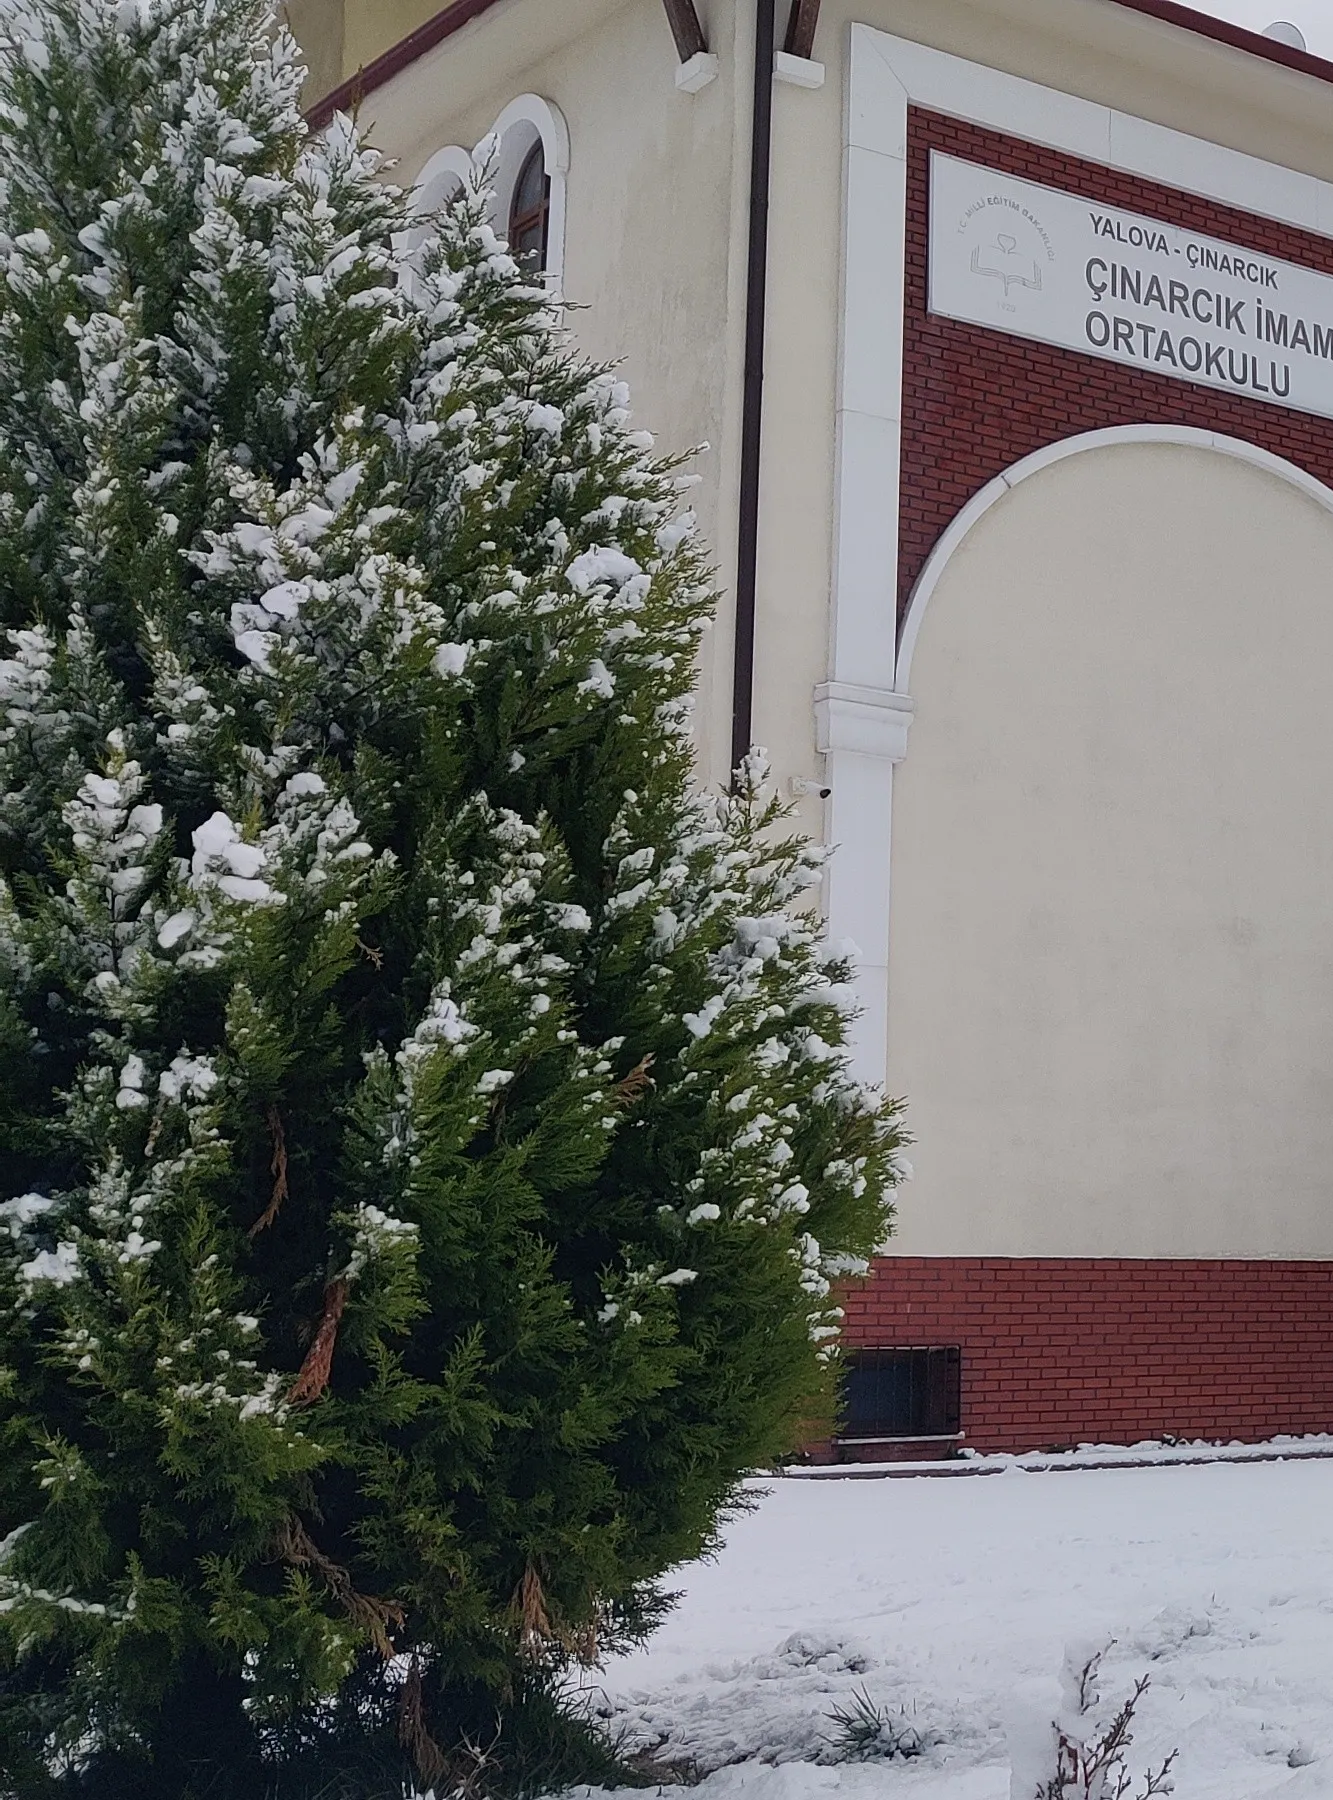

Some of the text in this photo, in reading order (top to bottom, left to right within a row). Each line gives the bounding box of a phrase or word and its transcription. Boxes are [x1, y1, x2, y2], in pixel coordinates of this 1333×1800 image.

[987, 195, 1020, 212] EĞİTİM
[1089, 212, 1170, 256] YALOVA
[1186, 243, 1279, 290] ÇINARCIK
[1085, 257, 1246, 336] ÇINARCIK
[1085, 311, 1290, 397] ORTAOKULU
